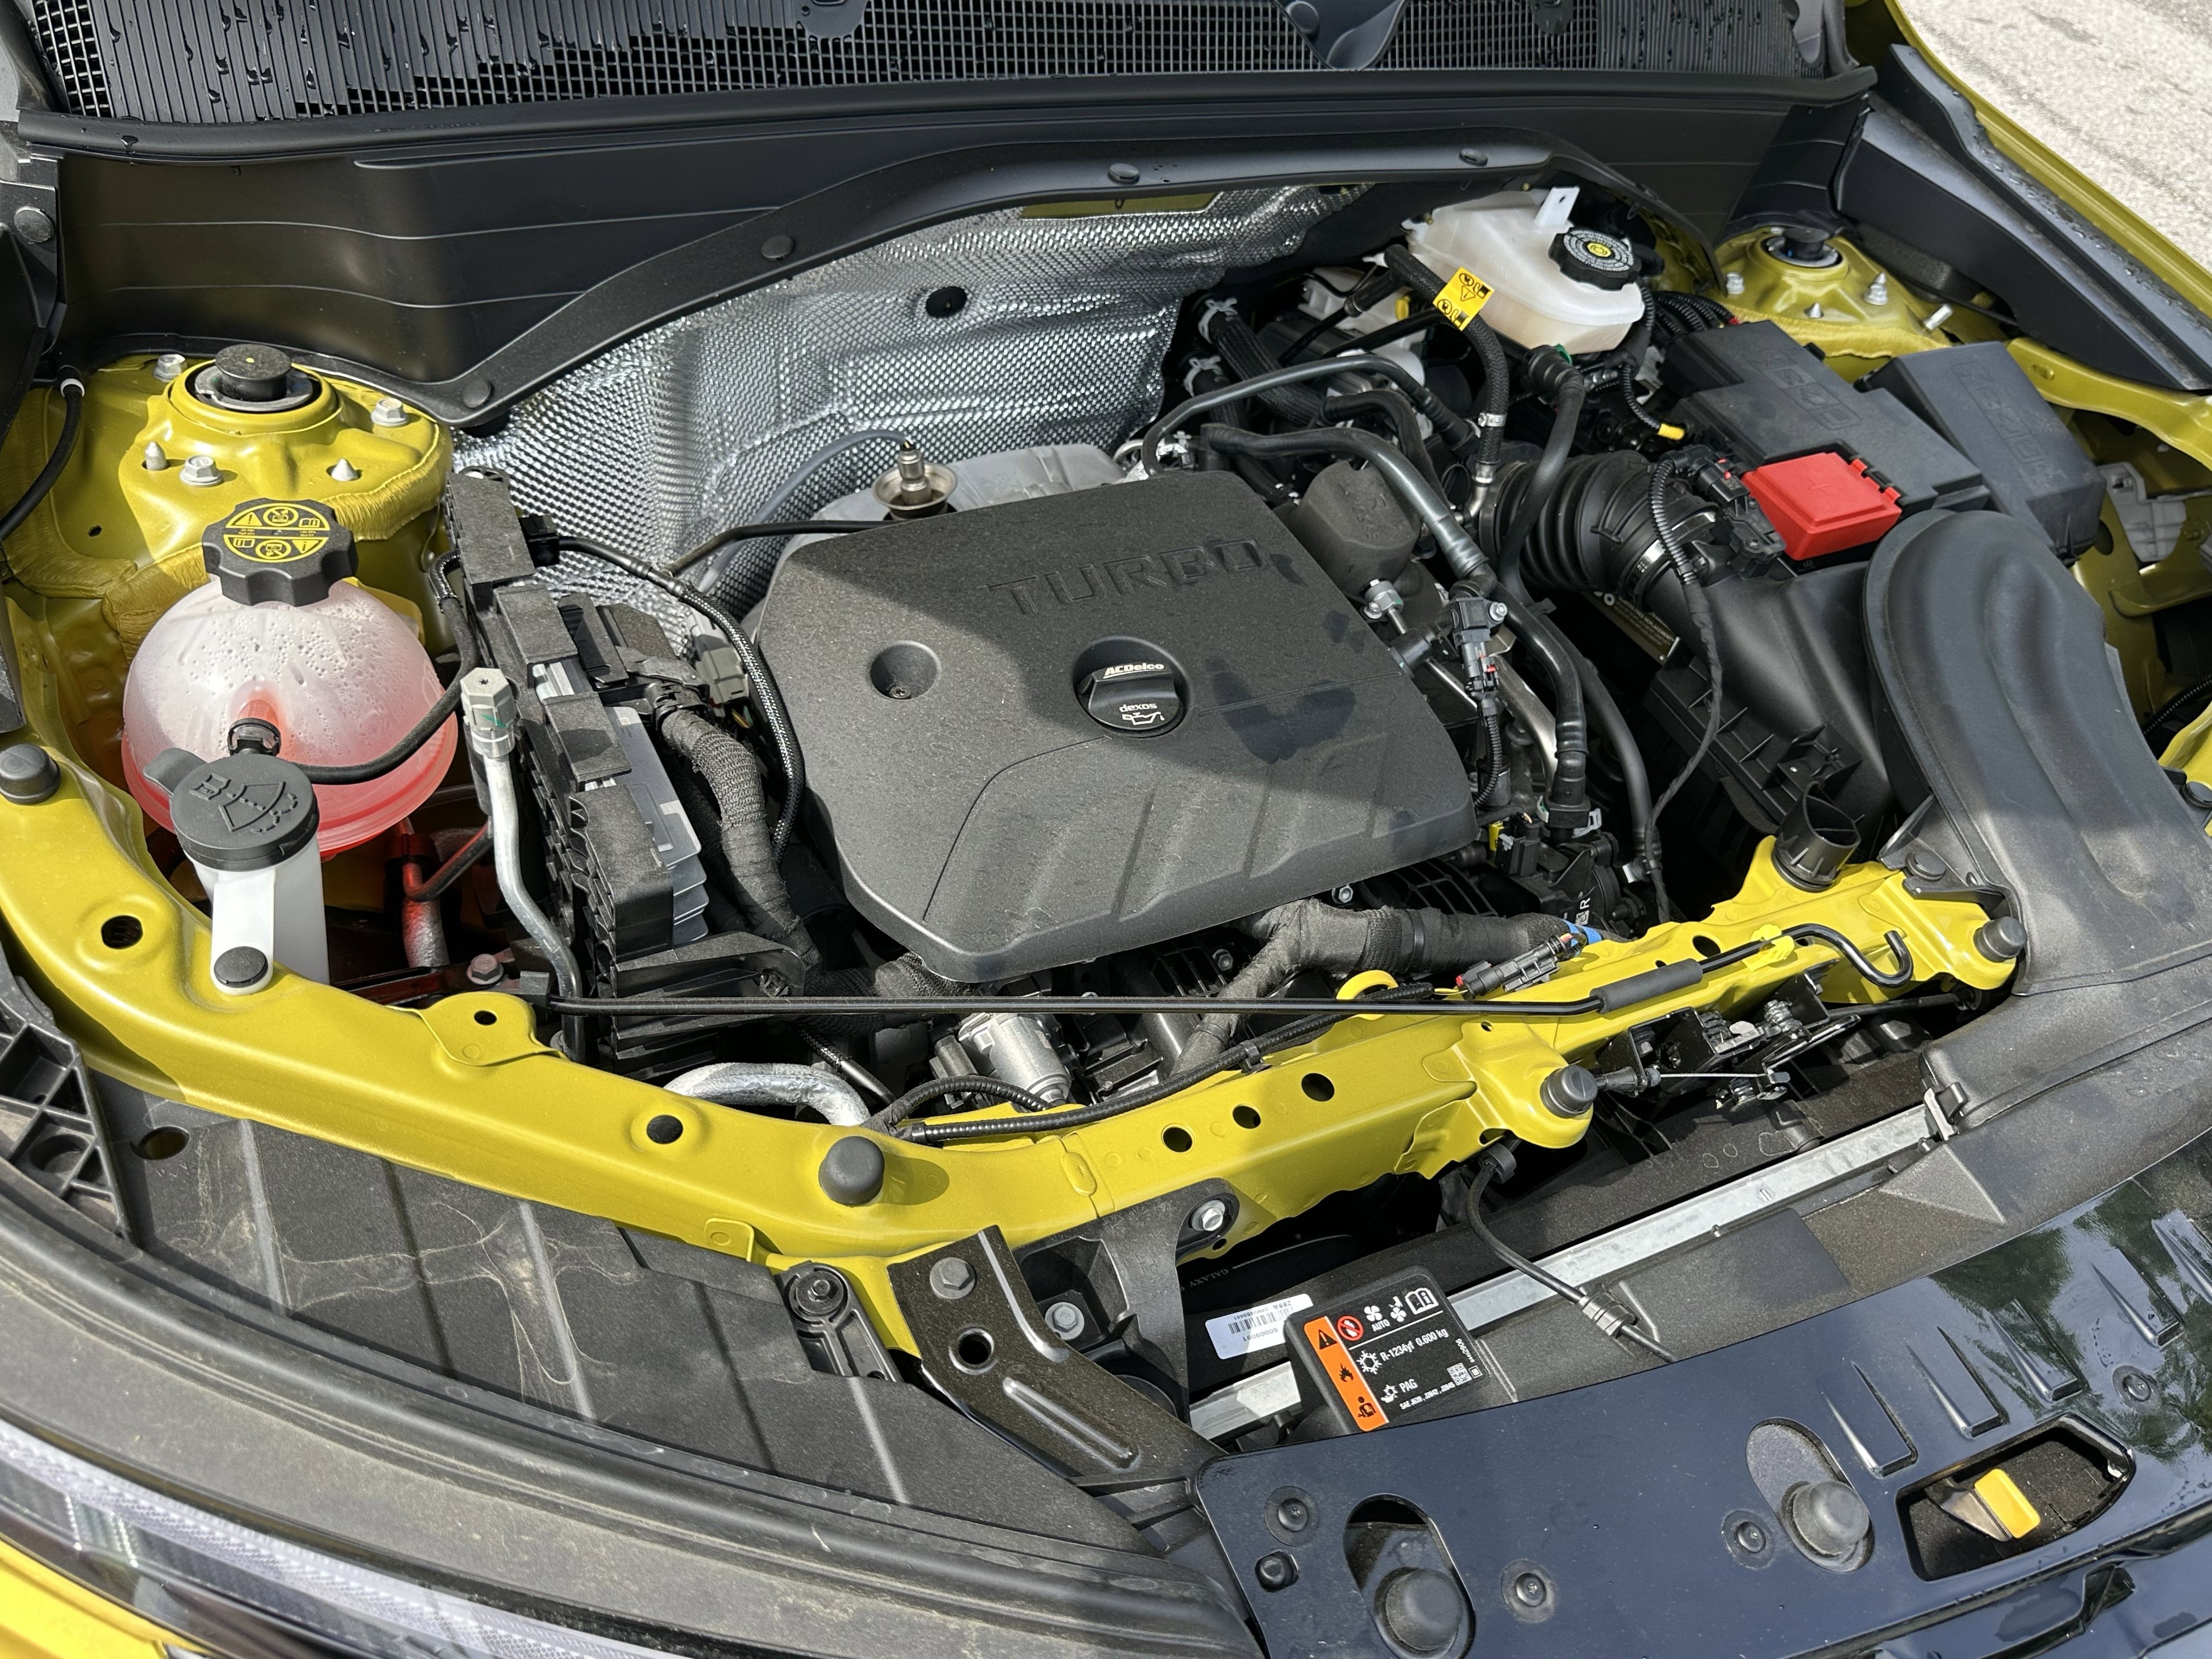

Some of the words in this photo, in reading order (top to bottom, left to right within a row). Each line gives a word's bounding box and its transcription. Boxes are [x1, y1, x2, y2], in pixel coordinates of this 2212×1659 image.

[989, 539, 1268, 614] TURBO
[1104, 663, 1164, 676] ACDelco
[1119, 703, 1158, 713] dexos
[1189, 1268, 1229, 1288] GALAXY
[1372, 1319, 1390, 1332] AUTO
[1380, 1340, 1415, 1362] R-1234yf
[1415, 1331, 1438, 1347] 0.600
[1435, 1329, 1449, 1339] kg
[1399, 1378, 1418, 1393] PAG
[1400, 1401, 1411, 1410] SAE
